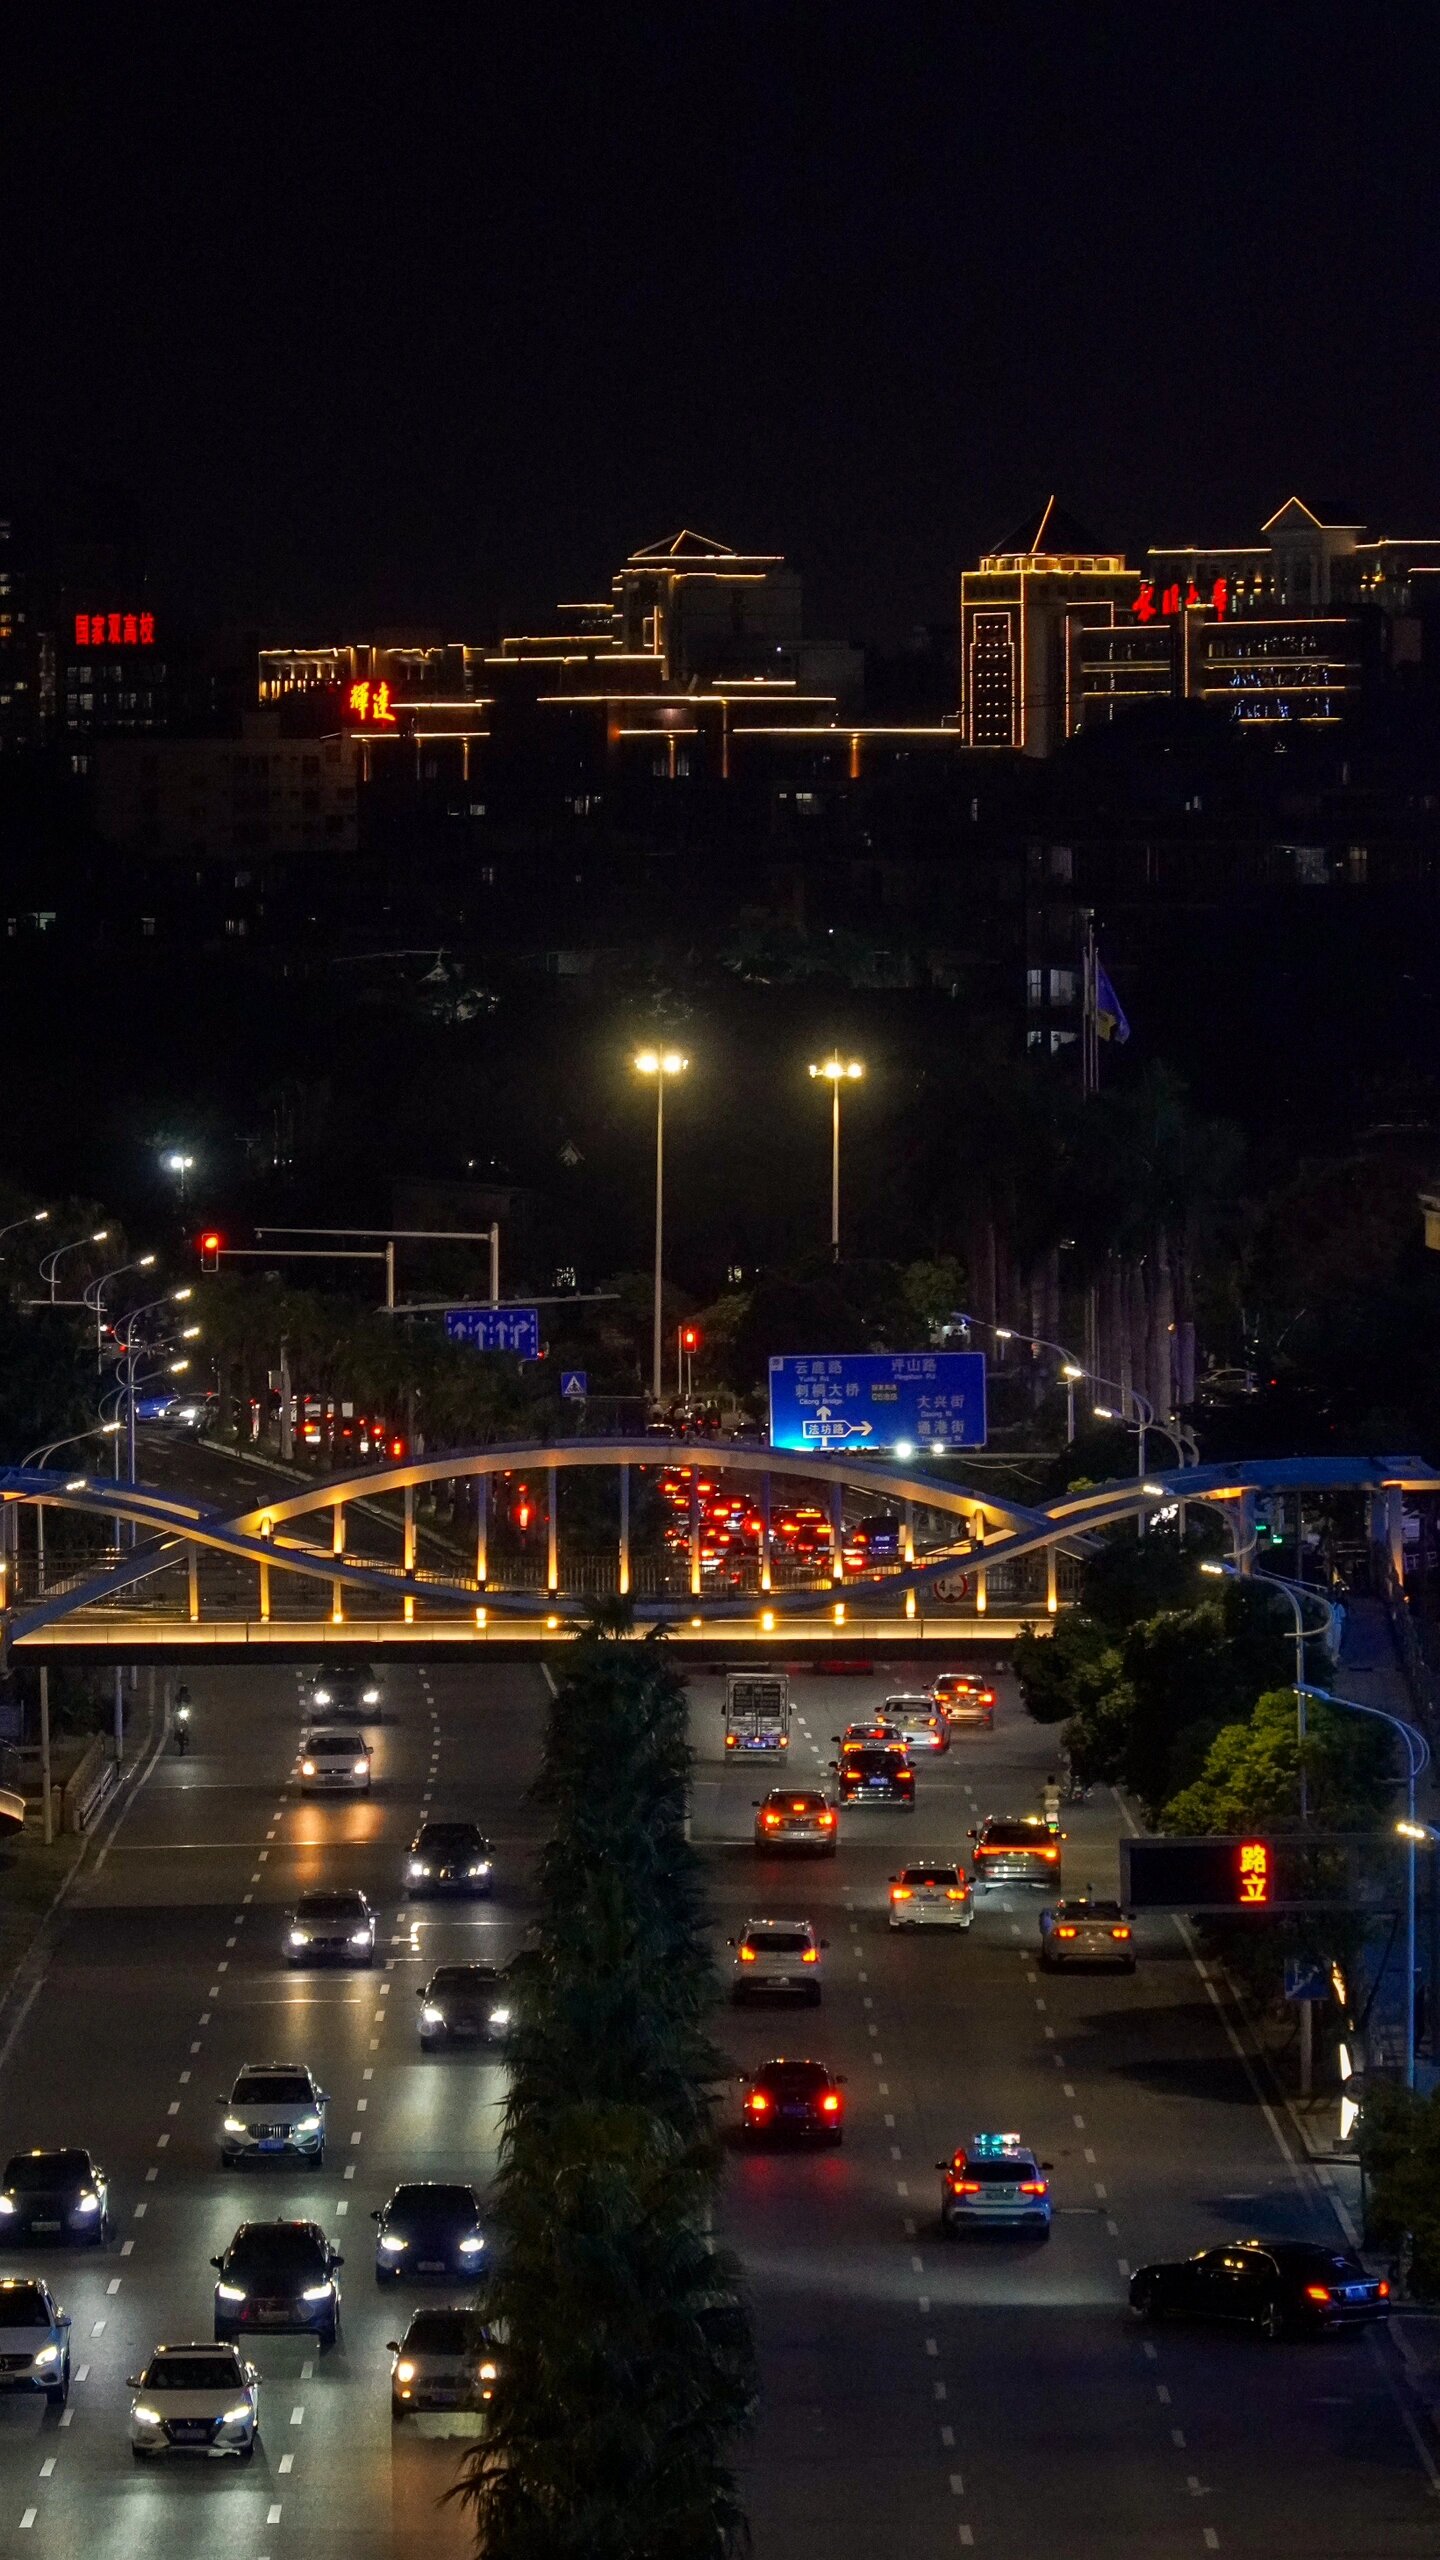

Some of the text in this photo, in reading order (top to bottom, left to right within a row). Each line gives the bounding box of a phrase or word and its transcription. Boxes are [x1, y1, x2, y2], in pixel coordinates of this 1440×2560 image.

[795, 1382, 860, 1398] 刺桐大桥
[917, 1394, 965, 1409] 大兴街
[917, 1419, 965, 1434] 通港街
[1239, 1844, 1267, 1873] 路
[1239, 1874, 1267, 1902] 立
